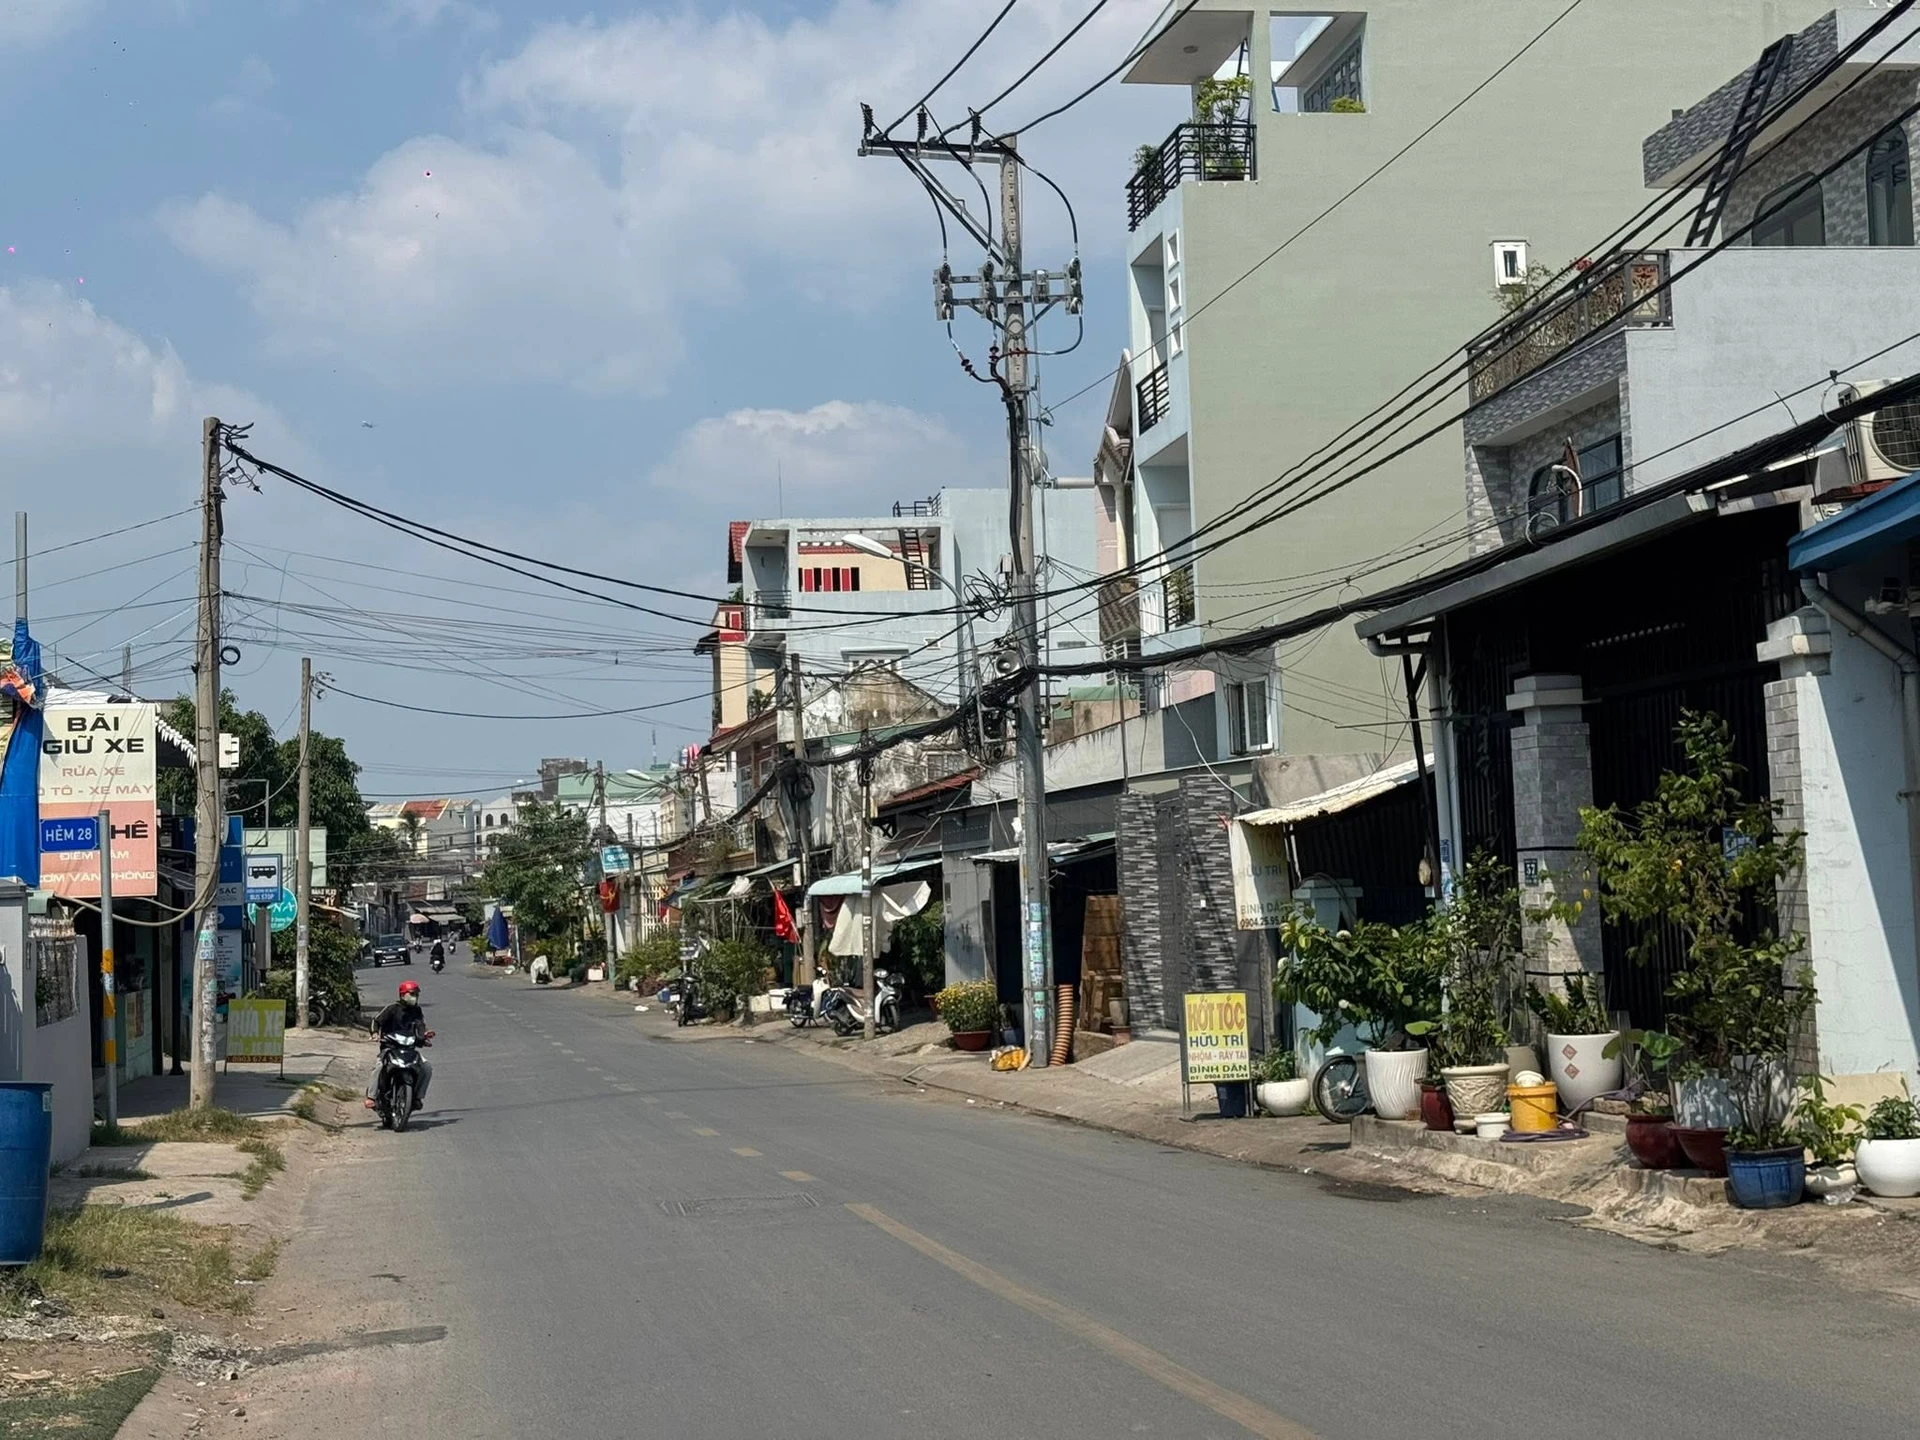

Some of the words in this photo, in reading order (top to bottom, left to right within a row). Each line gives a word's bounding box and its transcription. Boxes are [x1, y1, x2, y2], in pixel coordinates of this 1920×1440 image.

[68, 713, 119, 731] BÃI
[43, 736, 94, 754] GIỮ
[105, 738, 144, 753] XE
[104, 767, 125, 776] XE
[89, 786, 110, 796] XE
[78, 828, 92, 841] 28
[111, 820, 149, 840] HÊ
[1217, 995, 1245, 1031] TÓC
[1189, 1032, 1218, 1047] HỮU
[1223, 1032, 1244, 1046] TRÍ
[1190, 1065, 1219, 1074] BÌNH
[1222, 1063, 1247, 1073] DÂN
